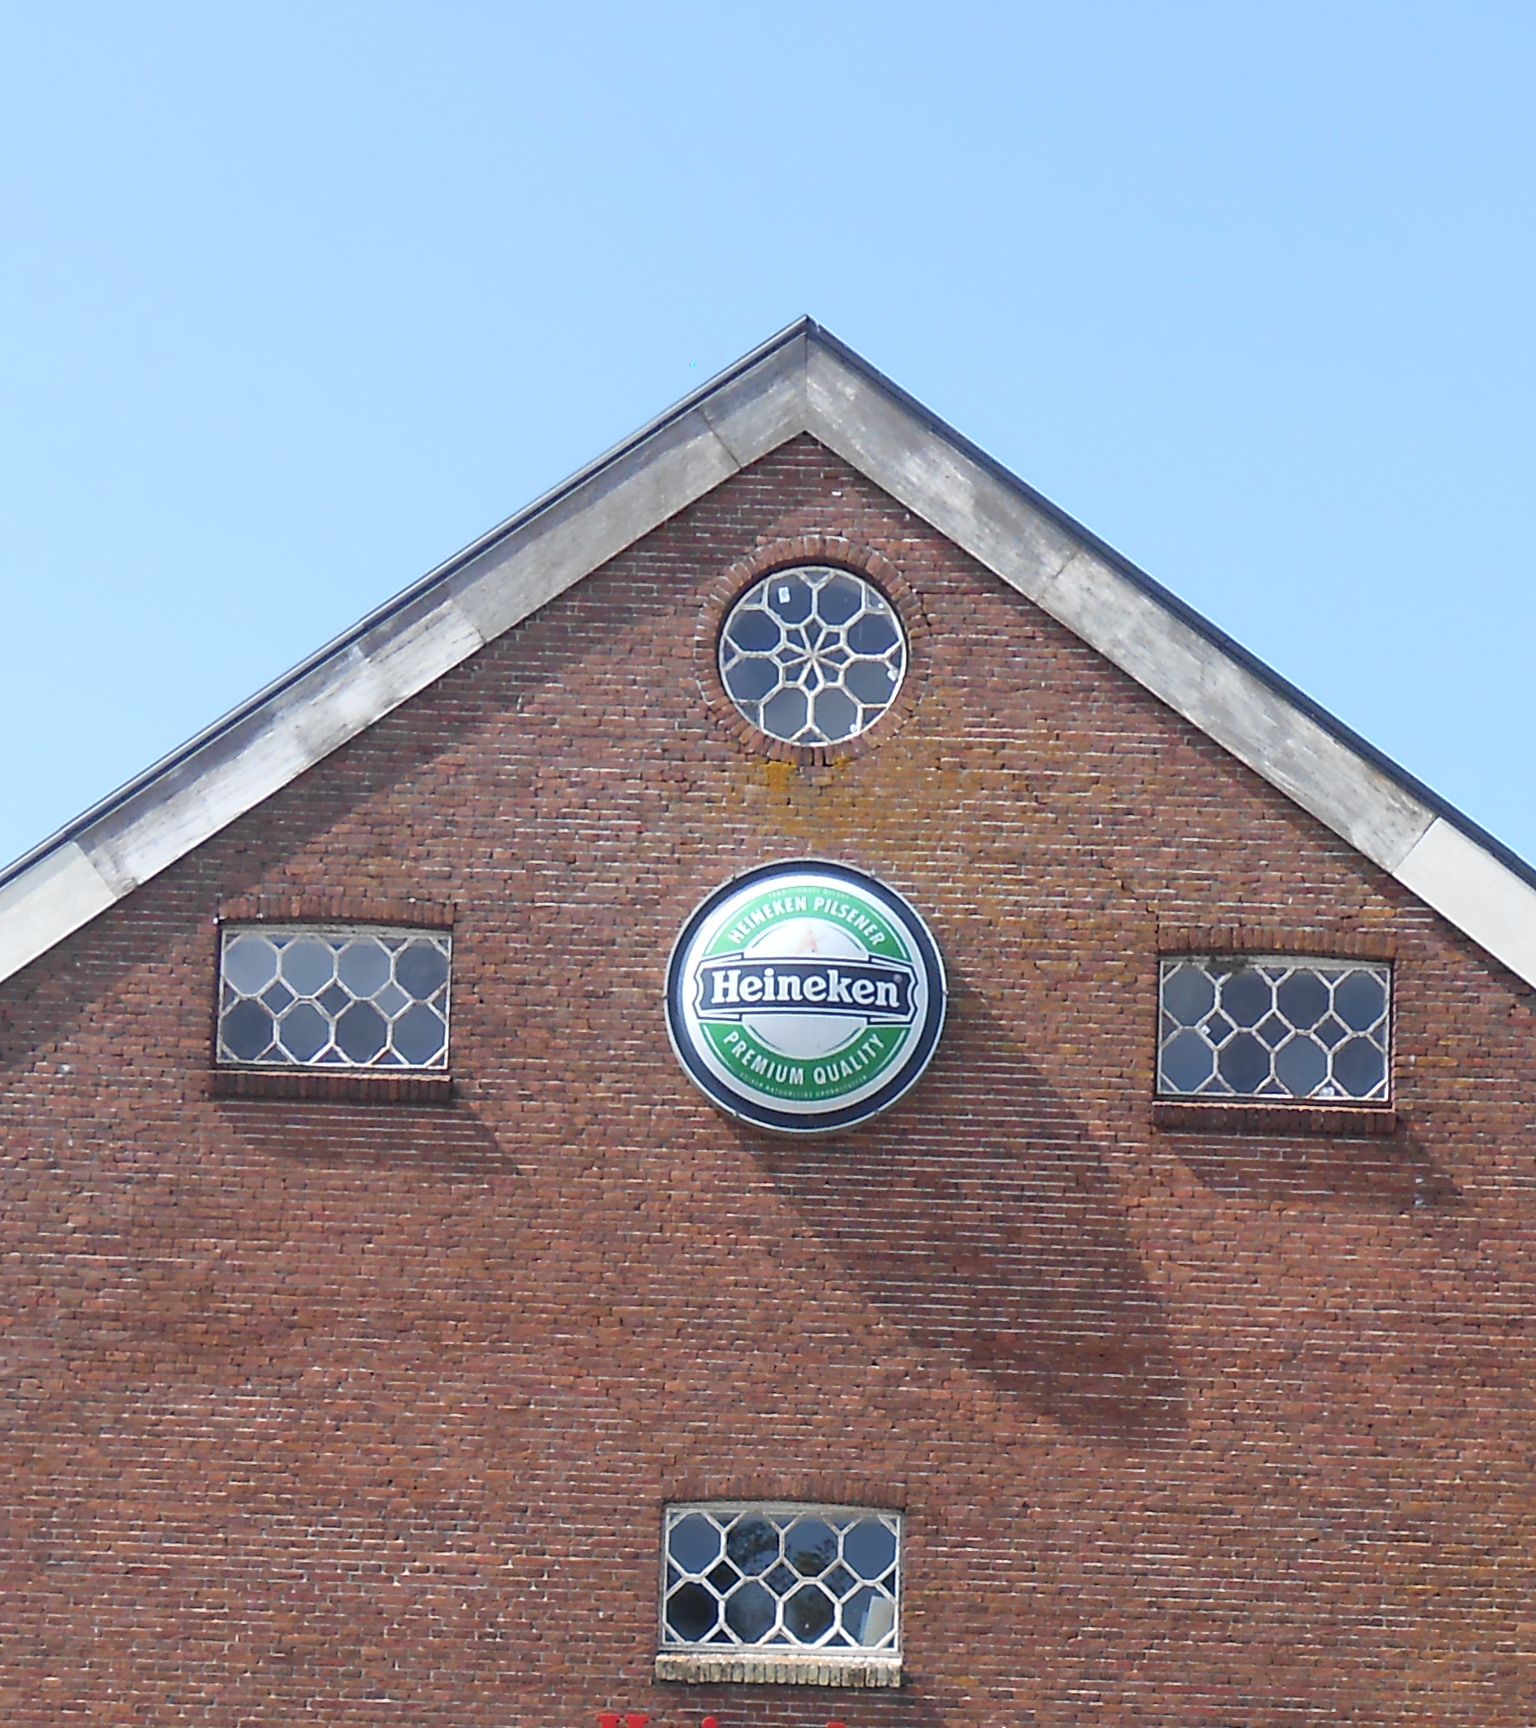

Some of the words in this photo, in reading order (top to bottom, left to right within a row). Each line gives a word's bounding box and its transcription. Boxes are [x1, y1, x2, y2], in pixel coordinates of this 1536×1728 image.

[727, 896, 807, 944] HEINEKEN
[813, 896, 886, 946] PILSENER
[710, 967, 900, 1008] Heineken
[723, 1031, 804, 1086] PREMIUM
[813, 1033, 886, 1086] QUALITY
